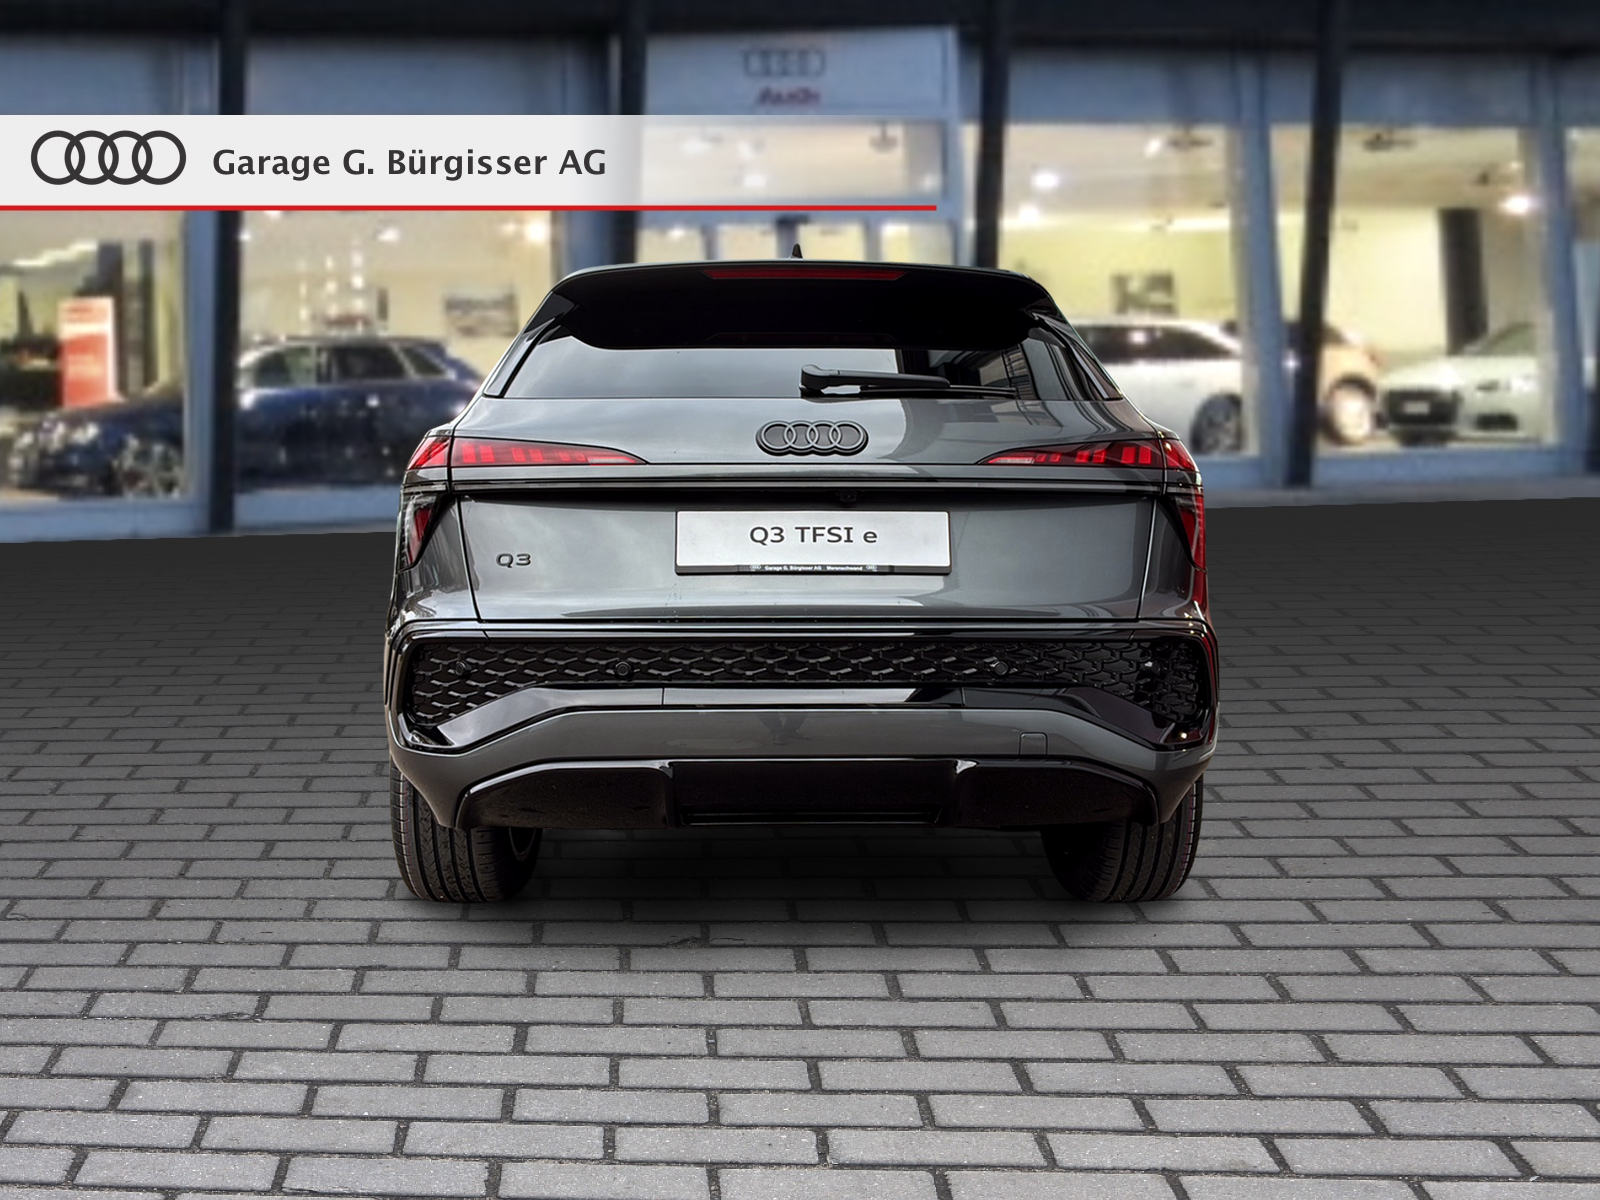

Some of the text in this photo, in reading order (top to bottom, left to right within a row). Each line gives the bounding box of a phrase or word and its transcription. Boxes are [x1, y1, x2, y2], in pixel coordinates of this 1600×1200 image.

[749, 526, 878, 546] Q3 TFSI e
[496, 553, 531, 568] Q3
